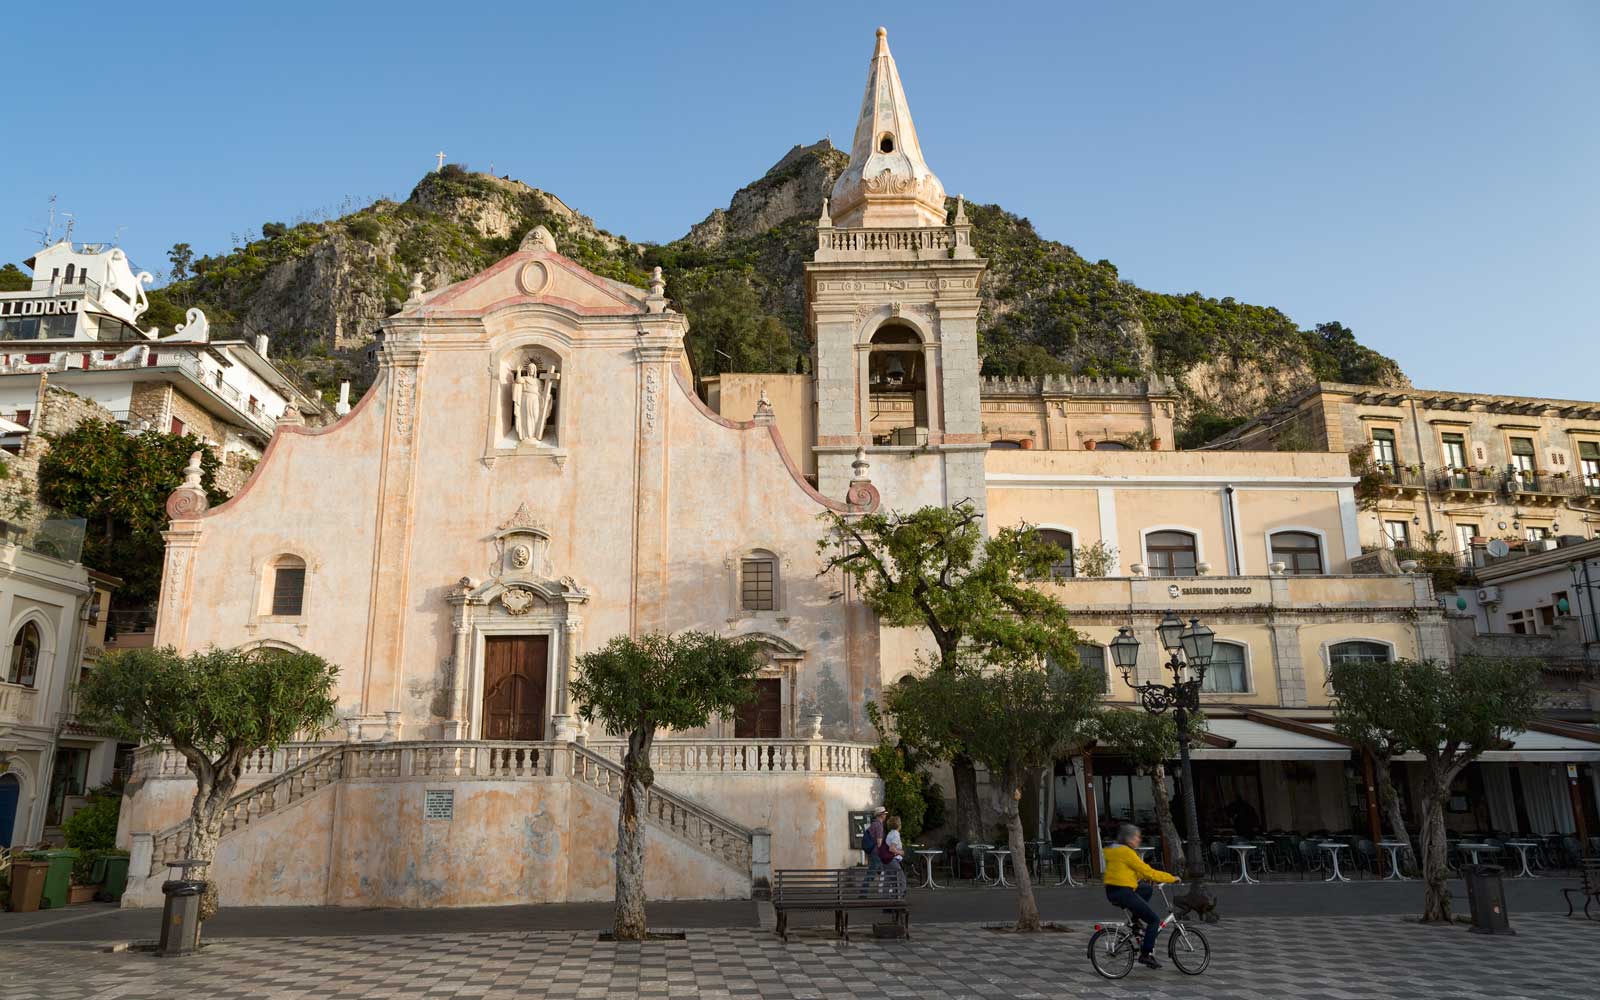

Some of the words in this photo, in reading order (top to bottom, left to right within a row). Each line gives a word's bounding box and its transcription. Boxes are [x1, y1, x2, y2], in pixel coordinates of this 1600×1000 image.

[1182, 587, 1213, 595] SALESIANI
[1214, 587, 1229, 595] DON
[1230, 587, 1252, 595] BOSCO
